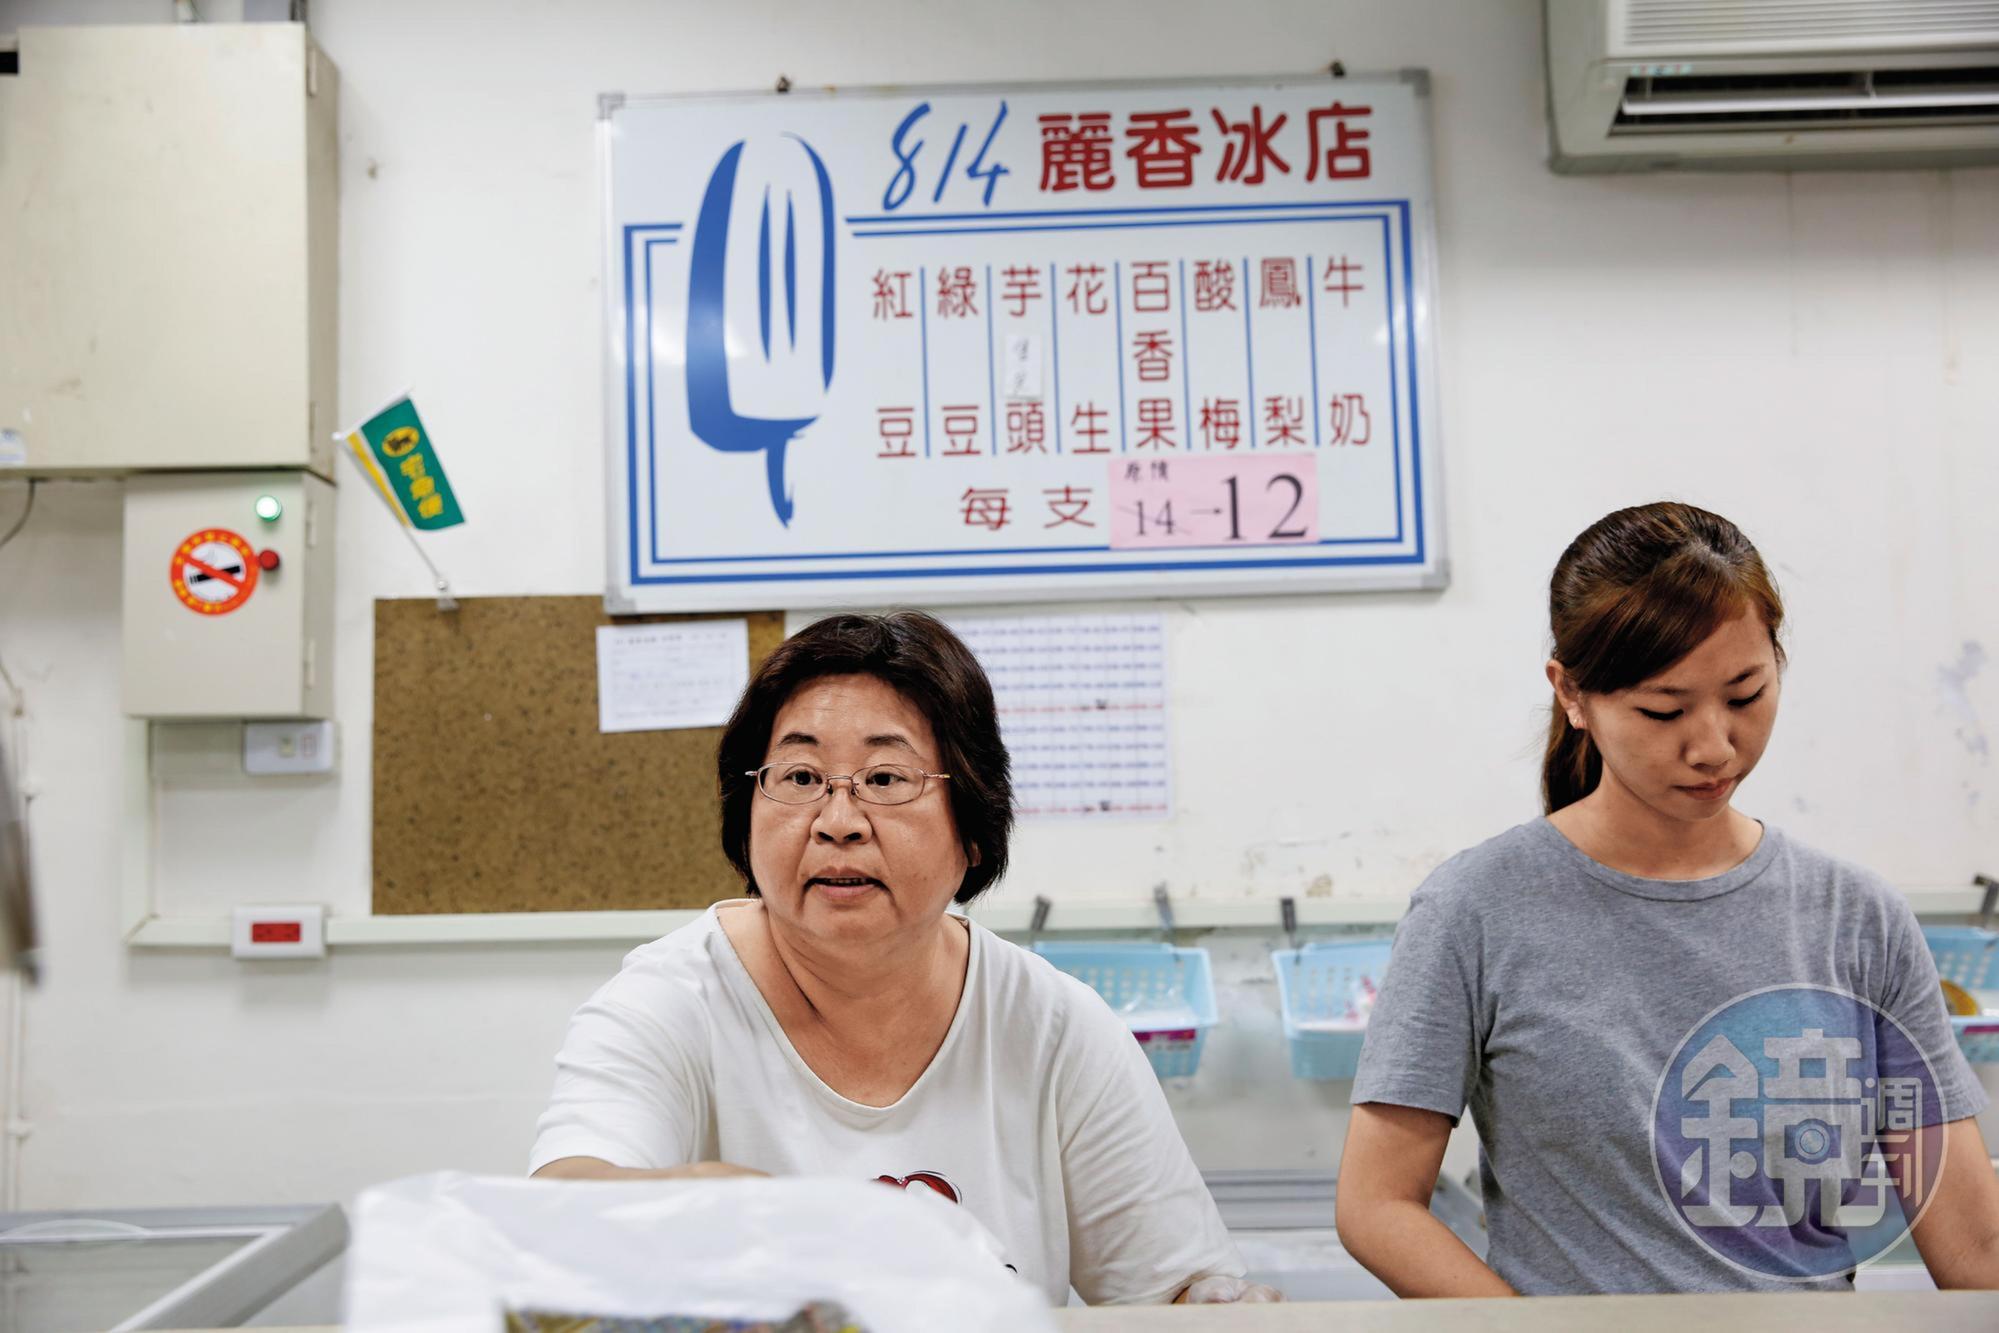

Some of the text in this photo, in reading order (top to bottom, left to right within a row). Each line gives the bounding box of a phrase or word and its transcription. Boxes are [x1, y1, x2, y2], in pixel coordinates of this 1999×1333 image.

[883, 100, 1373, 210] 814 麗香冰店
[872, 267, 917, 459] 紅豆
[937, 266, 981, 457] 綠豆
[1001, 264, 1047, 455] 芋頭
[1066, 263, 1111, 455] 花生
[1131, 260, 1176, 450] 百香果
[1194, 258, 1240, 450] 酸梅
[1259, 256, 1306, 447] 鳳梨
[1323, 254, 1371, 447] 牛奶
[960, 485, 1096, 531] 每支
[1133, 473, 1309, 541] 14 12
